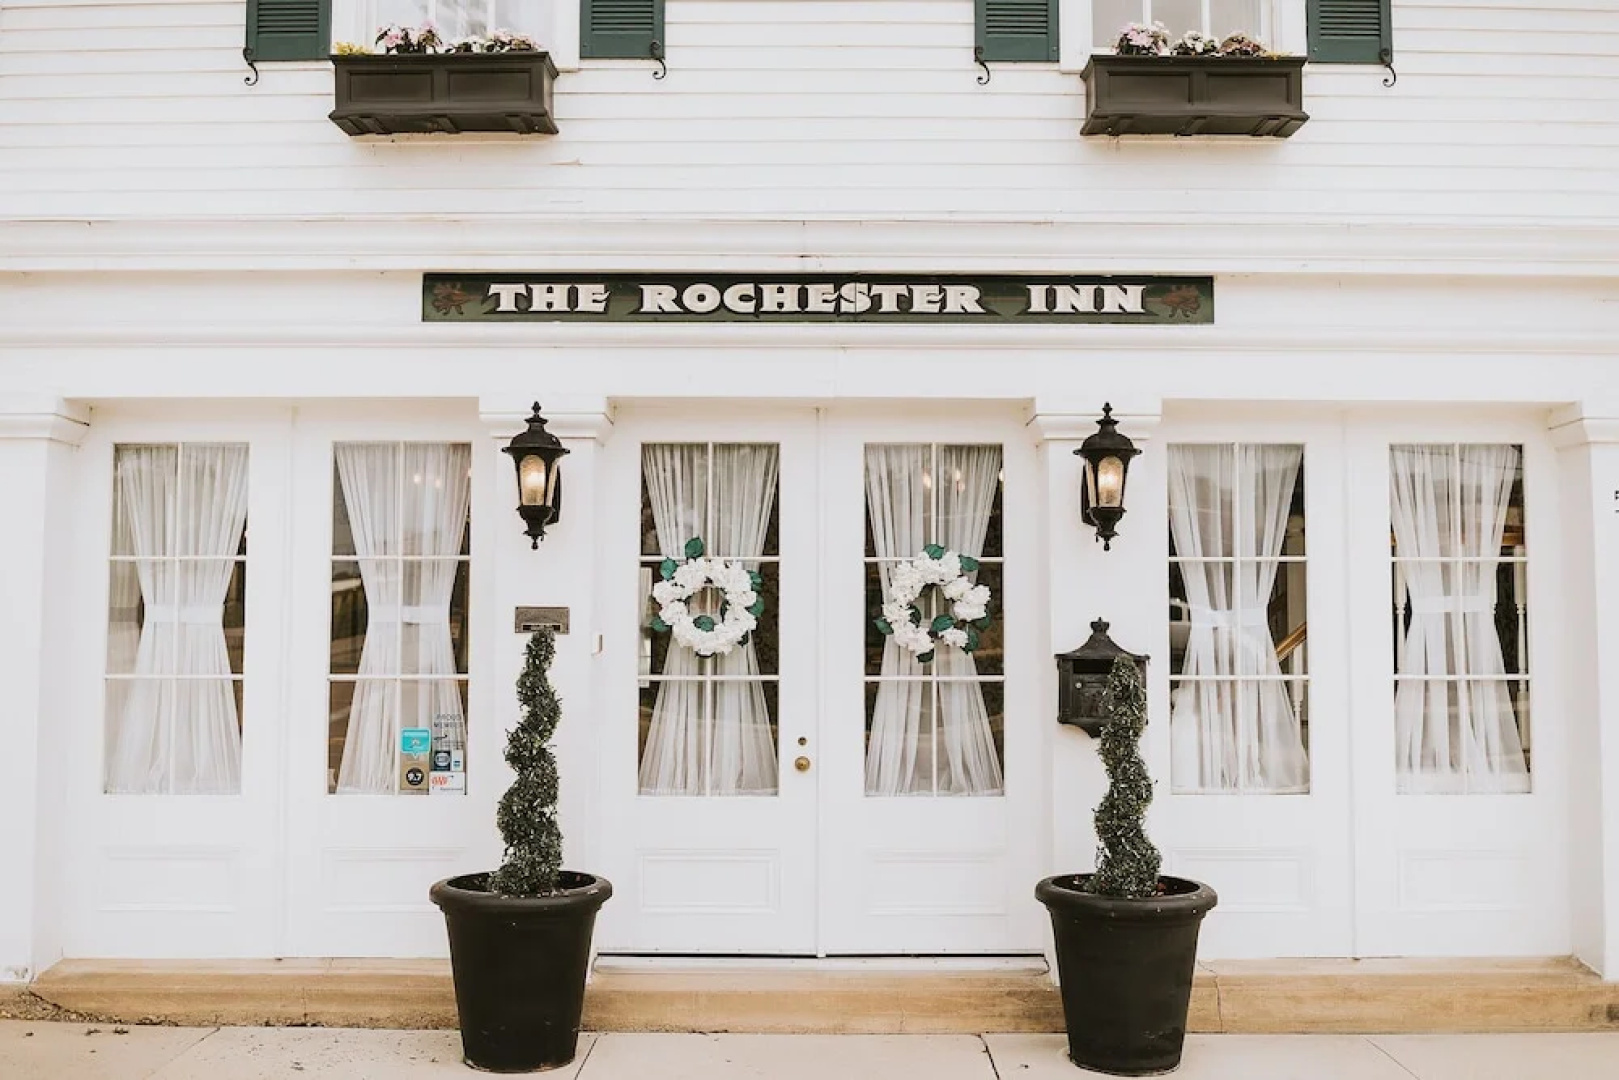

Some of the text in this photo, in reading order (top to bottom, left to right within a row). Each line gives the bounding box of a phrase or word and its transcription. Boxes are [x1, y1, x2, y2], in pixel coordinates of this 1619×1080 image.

[487, 282, 1147, 313] THE ROCHESTER INN
